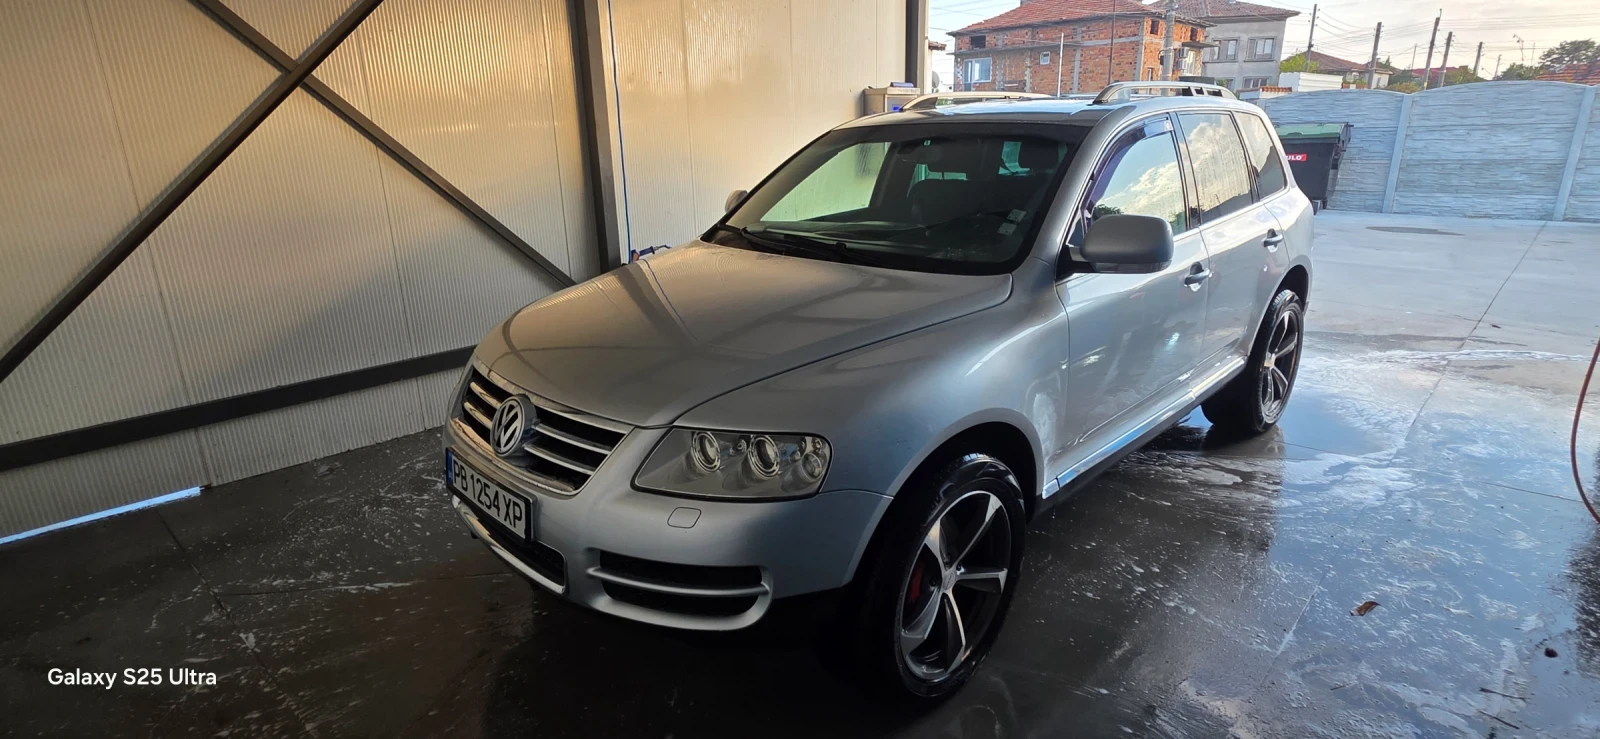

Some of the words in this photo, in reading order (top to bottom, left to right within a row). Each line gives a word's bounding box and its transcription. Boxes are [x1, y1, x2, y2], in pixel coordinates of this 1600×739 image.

[491, 398, 524, 456] VW
[453, 460, 468, 491] PB
[470, 474, 500, 517] 1254
[503, 494, 522, 528] XP
